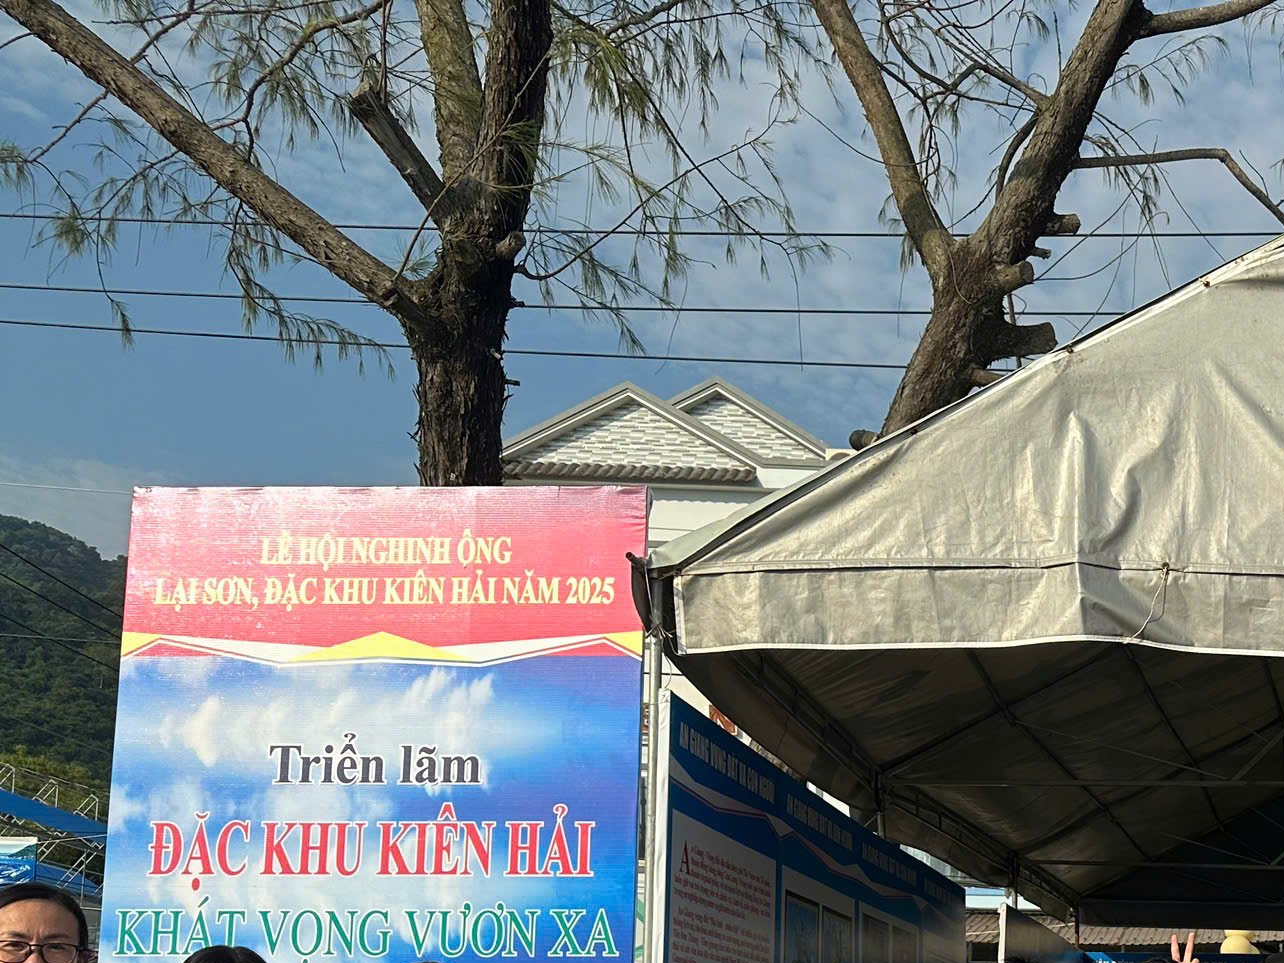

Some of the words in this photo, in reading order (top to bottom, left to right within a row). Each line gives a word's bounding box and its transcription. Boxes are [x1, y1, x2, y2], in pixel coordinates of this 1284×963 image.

[299, 533, 344, 572] HỘI
[352, 536, 452, 565] NGHINH
[154, 577, 198, 612] LẠI
[264, 573, 318, 612] ĐẶC
[323, 577, 379, 605] KHU
[384, 569, 445, 605] KIÊN
[450, 569, 498, 605] HẢI
[501, 569, 561, 605] NĂM
[565, 577, 616, 605] 2025
[269, 732, 387, 785] Triển
[399, 744, 483, 785] lãm
[148, 812, 251, 891] ĐẶC
[260, 821, 367, 877] KHU
[376, 802, 496, 878] KIÊN
[504, 804, 596, 878] HẢI
[113, 895, 246, 957] KHÁT
[404, 901, 540, 958] VƯƠN
[548, 908, 619, 958] XA
